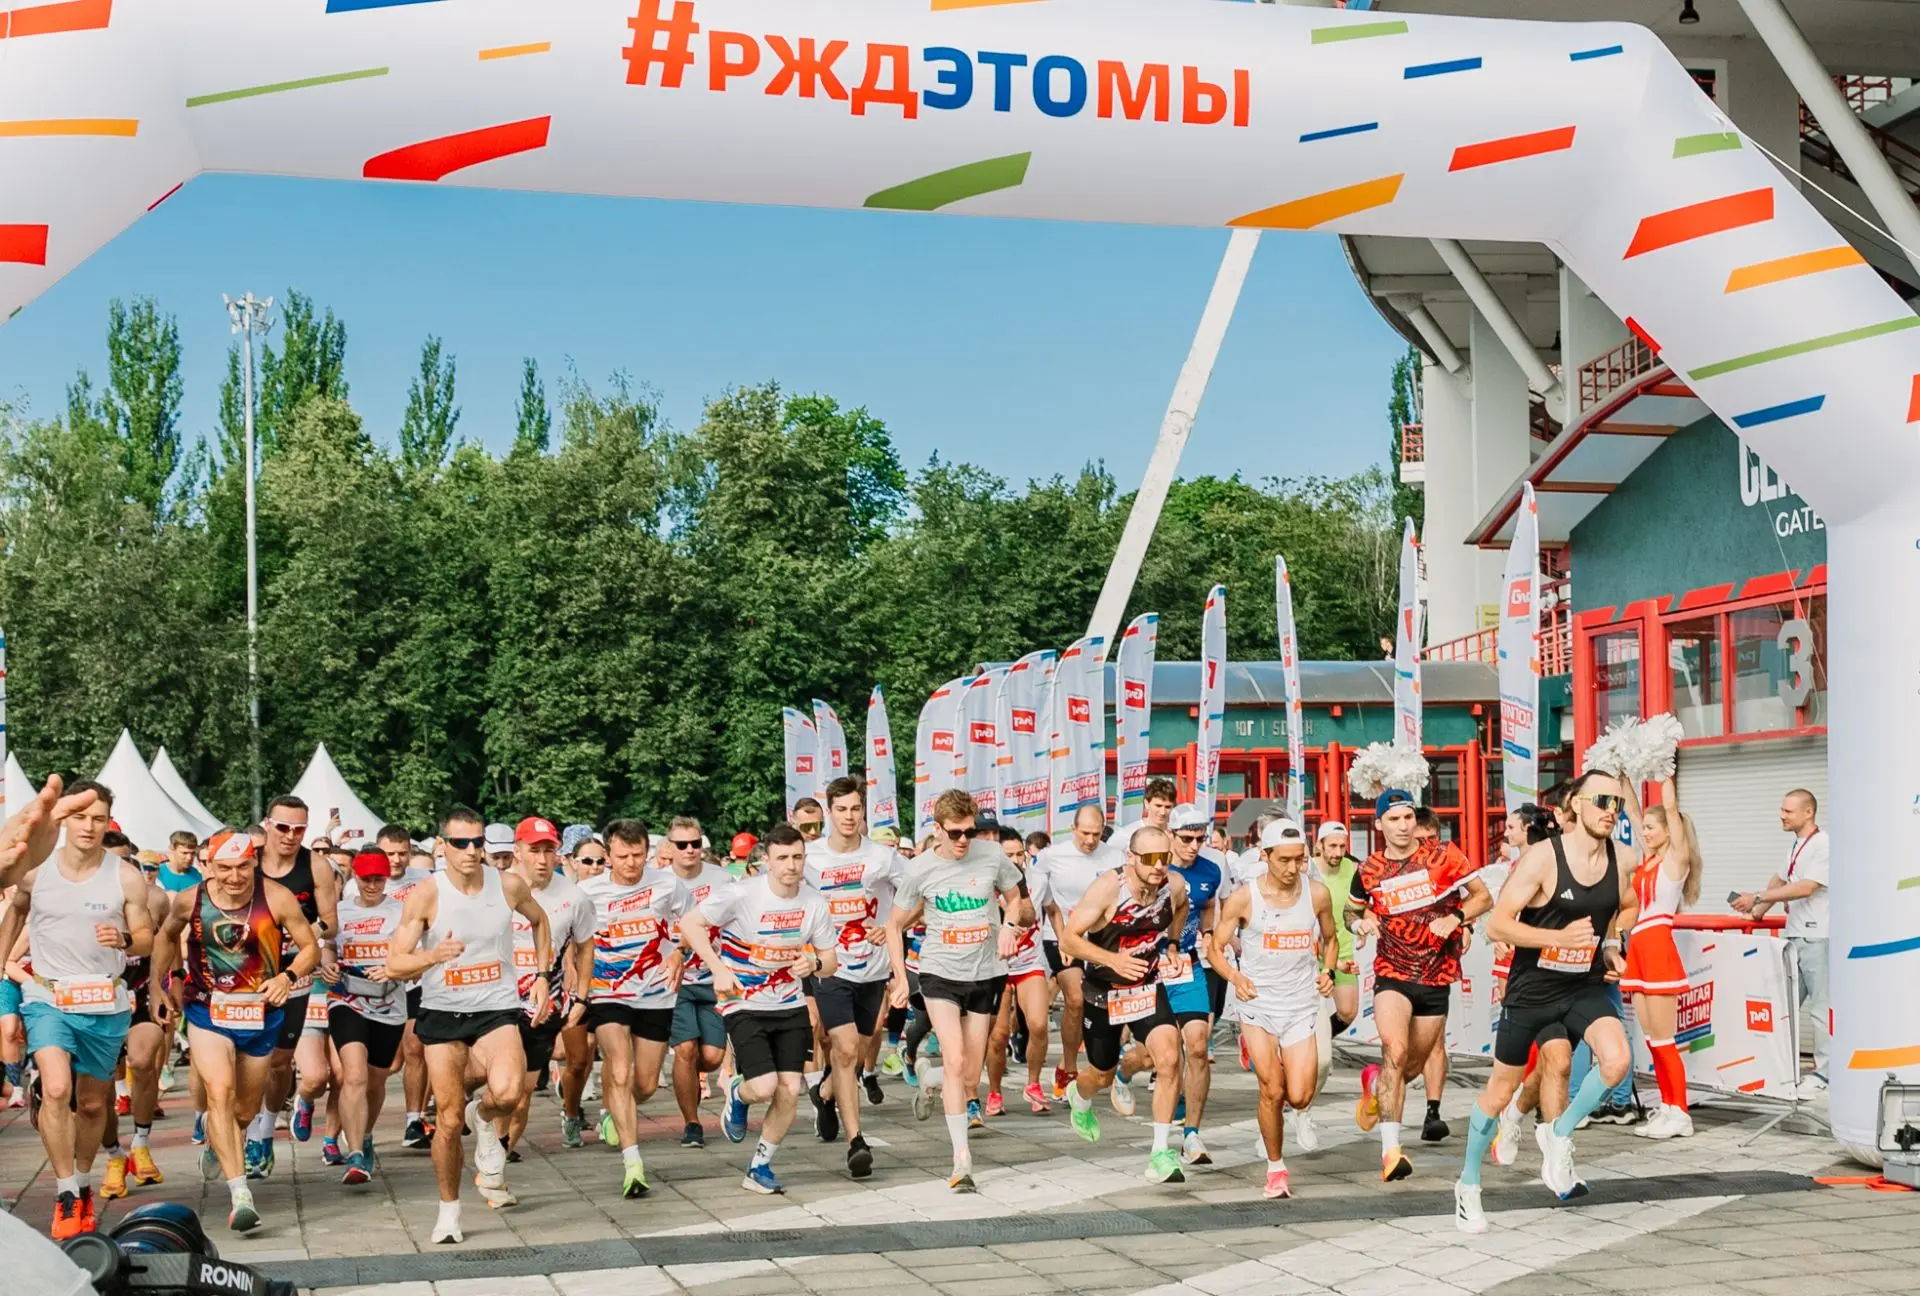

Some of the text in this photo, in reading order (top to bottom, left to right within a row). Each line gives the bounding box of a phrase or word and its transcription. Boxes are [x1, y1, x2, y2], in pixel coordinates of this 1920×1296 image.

[1776, 506, 1824, 537] GATE
[1778, 620, 1813, 706] 3
[1272, 720, 1313, 736] SOH
[1399, 883, 1431, 901] 5038
[623, 921, 655, 935] 5163
[956, 929, 988, 942] 5239
[1278, 935, 1310, 948] 5050
[355, 946, 387, 957] 5166
[1557, 948, 1591, 962] 5291
[462, 966, 499, 983] 5315
[72, 988, 112, 1003] 5526
[1677, 984, 1711, 1009] СТИГАЯ
[226, 1006, 262, 1020] 5008
[1678, 1002, 1710, 1029] ЦЕЛИ!
[201, 1263, 253, 1295] RONIN
